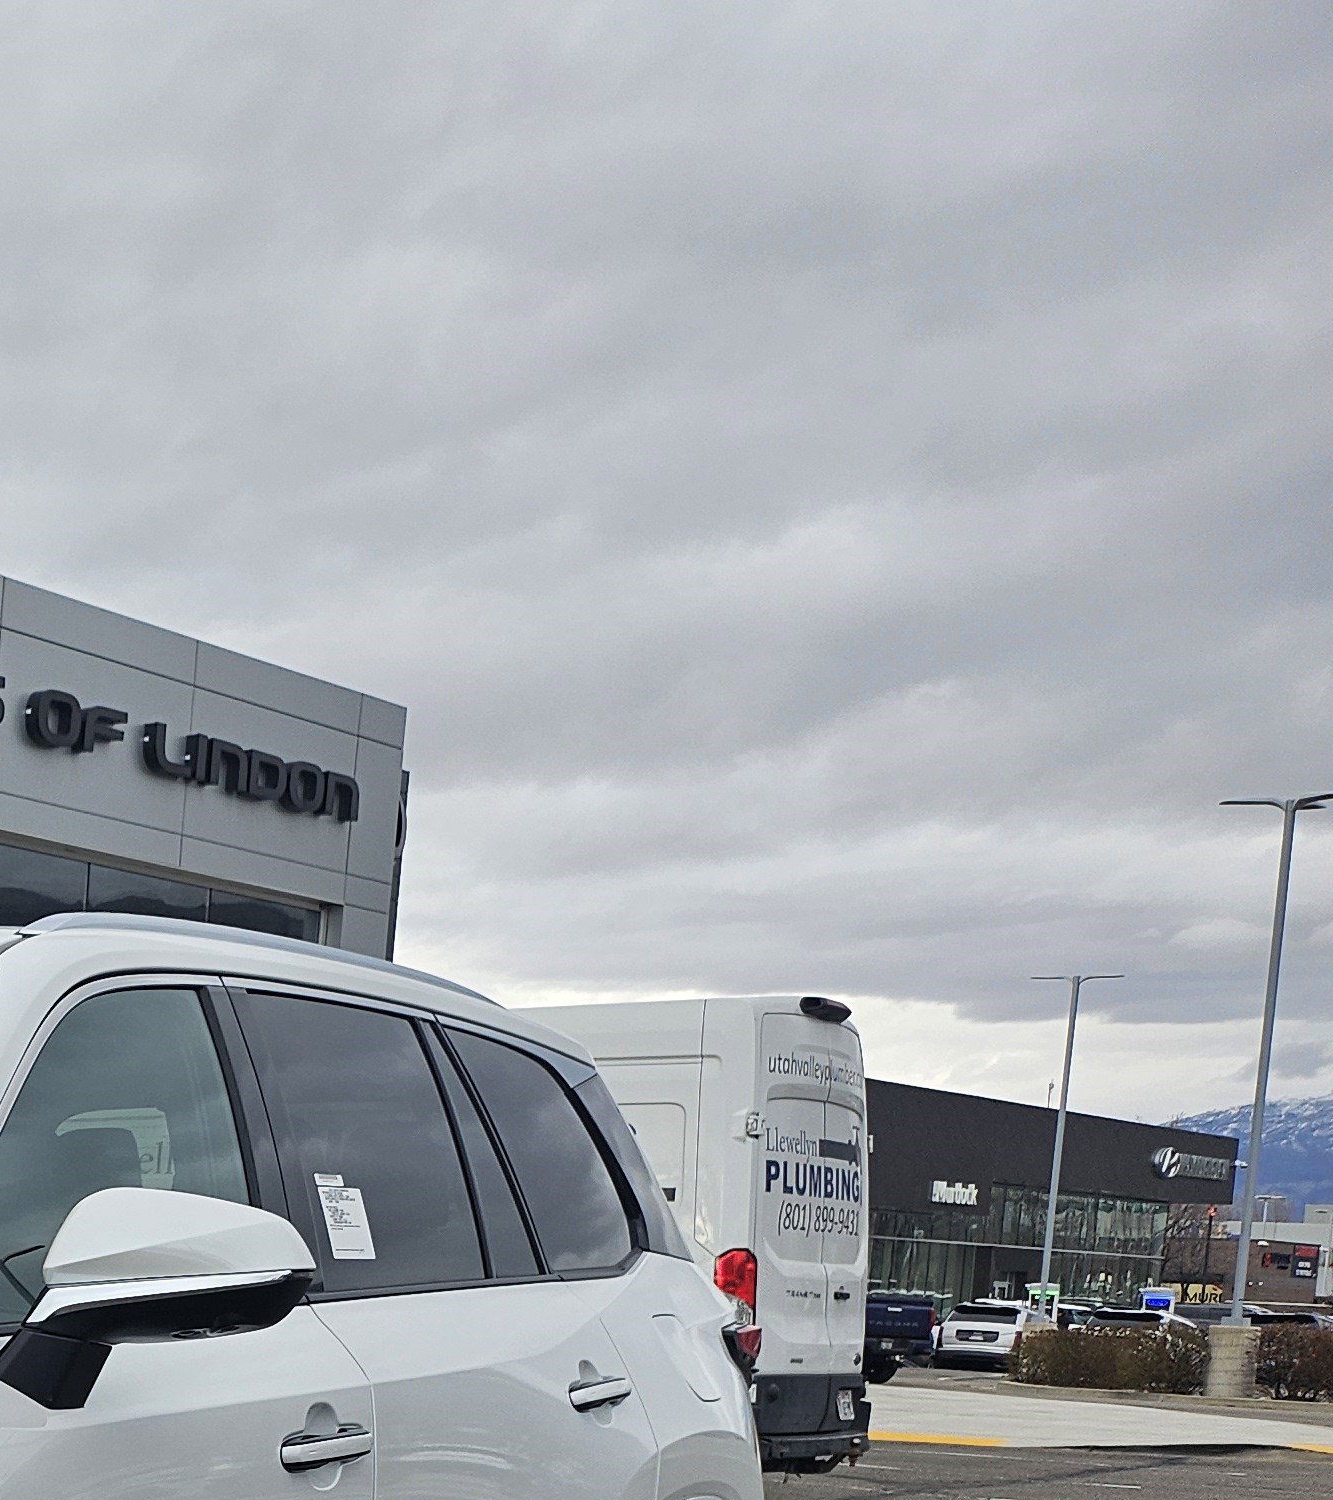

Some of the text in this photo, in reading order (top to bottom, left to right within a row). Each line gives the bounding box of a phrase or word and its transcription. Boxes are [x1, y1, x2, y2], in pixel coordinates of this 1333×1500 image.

[24, 689, 129, 753] OF
[142, 722, 360, 824] LINDON
[765, 1126, 818, 1164] Llewellyn
[764, 1159, 861, 1203] PLUMBING
[777, 1199, 860, 1238] (801) 899-9431
